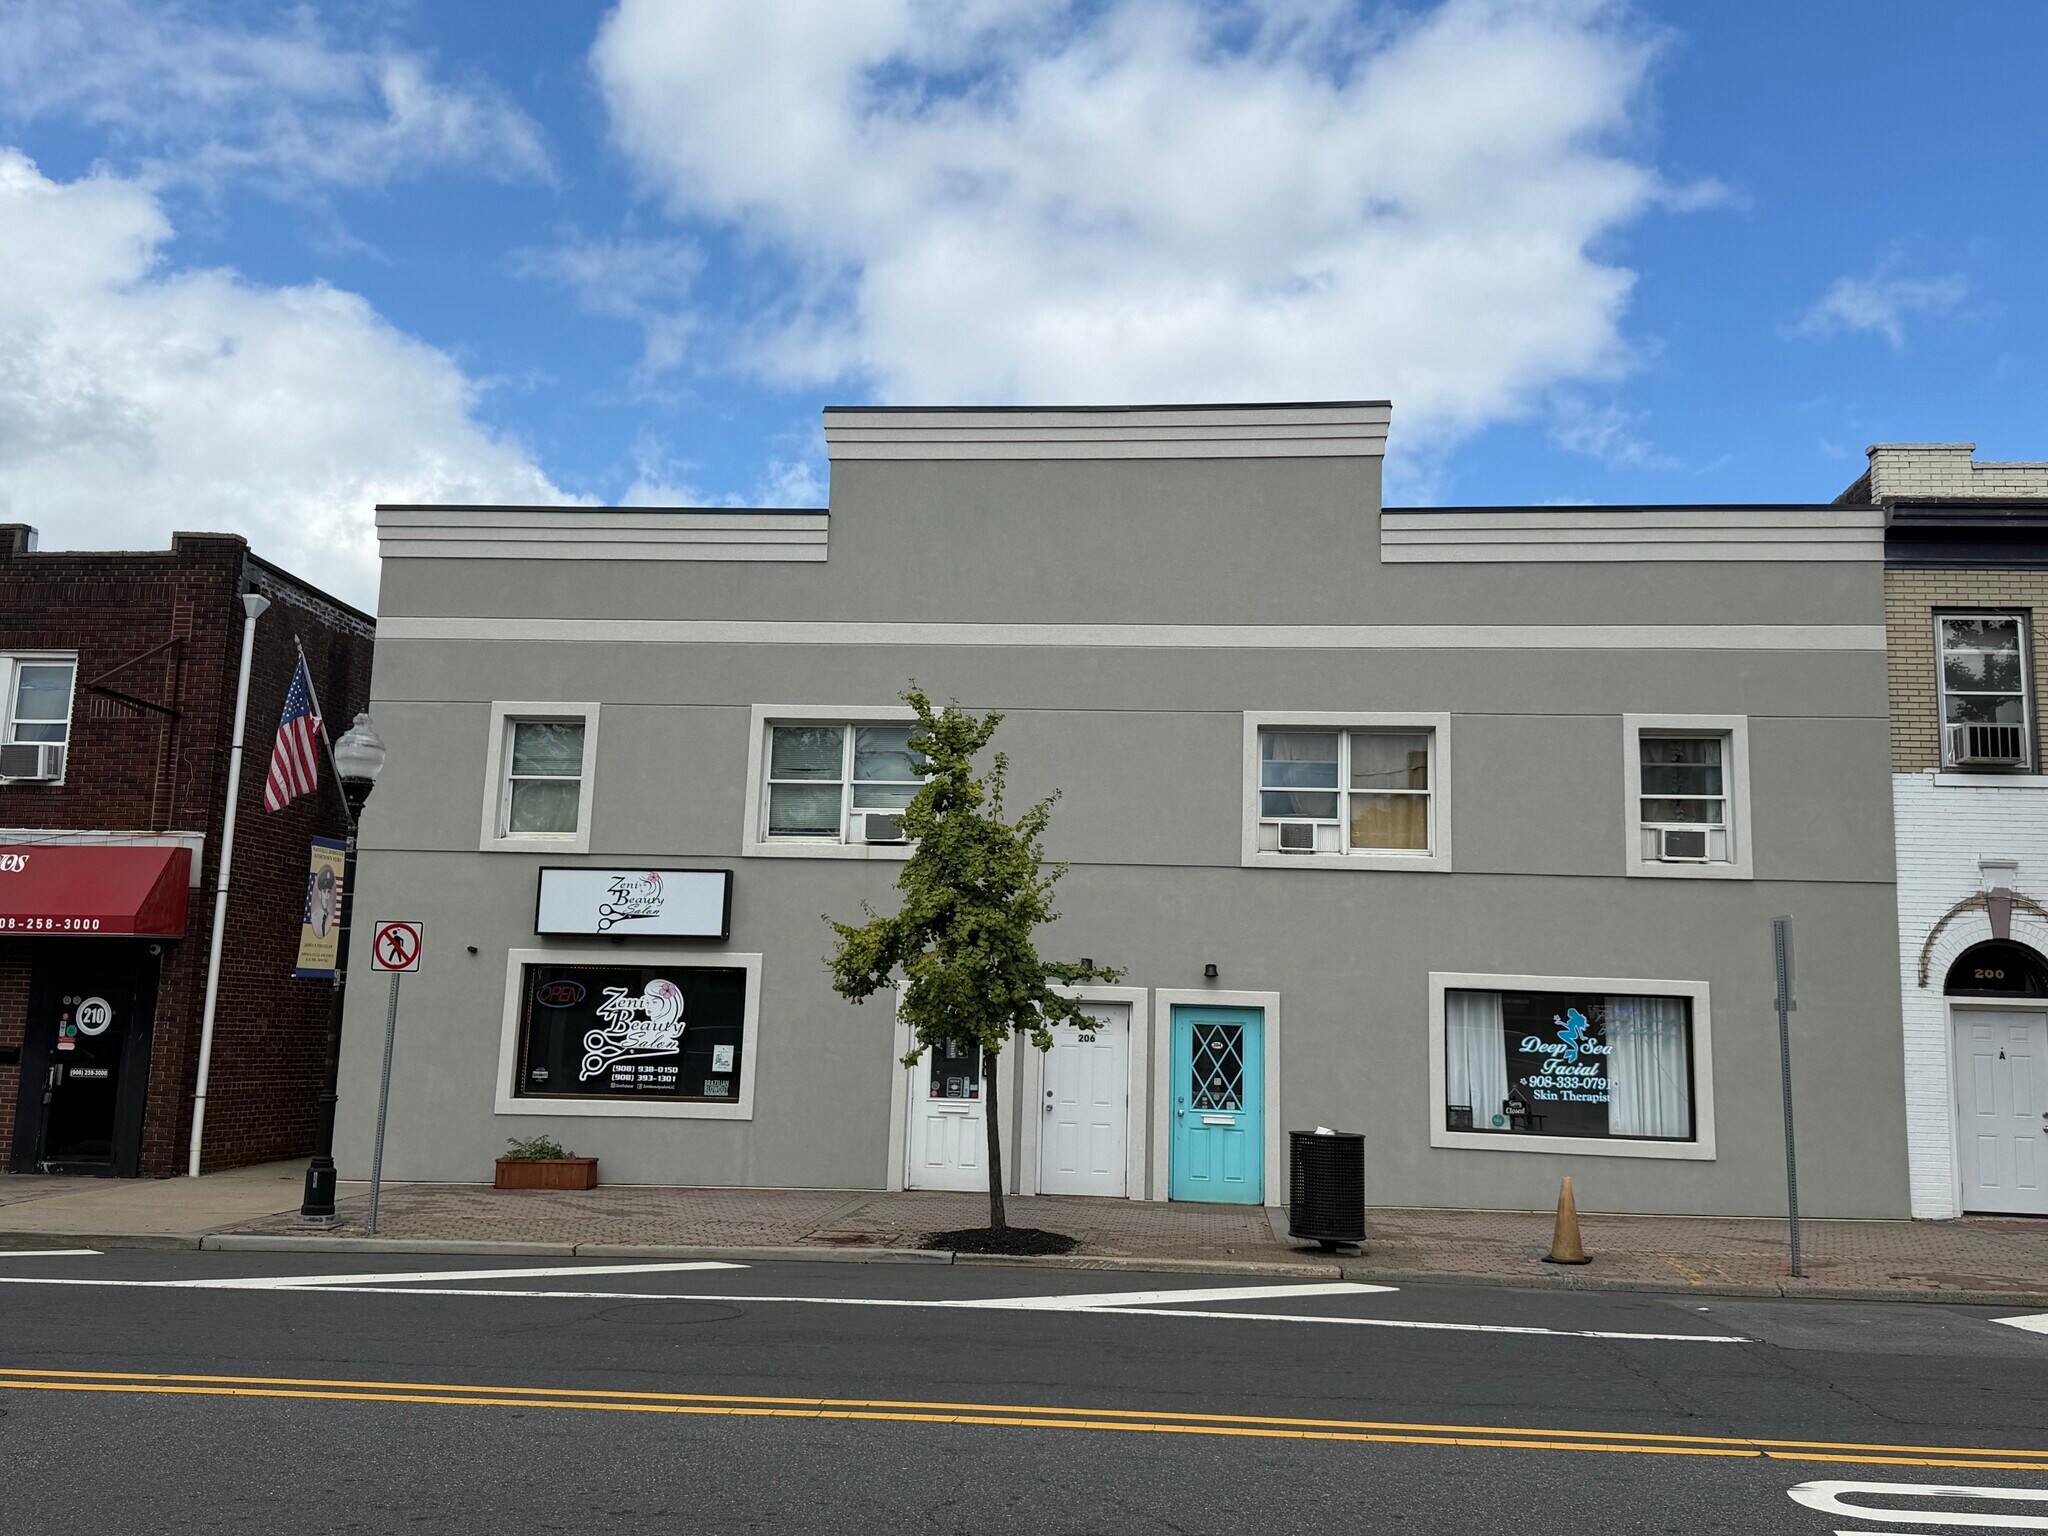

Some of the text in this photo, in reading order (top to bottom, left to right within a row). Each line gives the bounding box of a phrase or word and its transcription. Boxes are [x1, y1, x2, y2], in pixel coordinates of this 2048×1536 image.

[607, 876, 638, 893] Zeni
[612, 889, 665, 907] Beauty
[622, 903, 660, 915] Salon
[1974, 968, 2005, 979] 200
[540, 986, 581, 1002] OPEN
[597, 987, 646, 1016] Zeni
[83, 1007, 105, 1024] 210
[606, 1008, 685, 1037] Beauty
[621, 1031, 680, 1049] Salon
[1078, 1034, 1096, 1043] 206
[1519, 1036, 1616, 1057] Deep Sea
[1999, 1051, 2006, 1060] A
[612, 1065, 635, 1073] (908)
[1540, 1058, 1600, 1076] Facial
[611, 1073, 635, 1082] (908)
[1529, 1075, 1612, 1090] 908-333-0791
[1533, 1090, 1612, 1104] Skin Therapist
[1505, 1107, 1526, 1115] Closed
